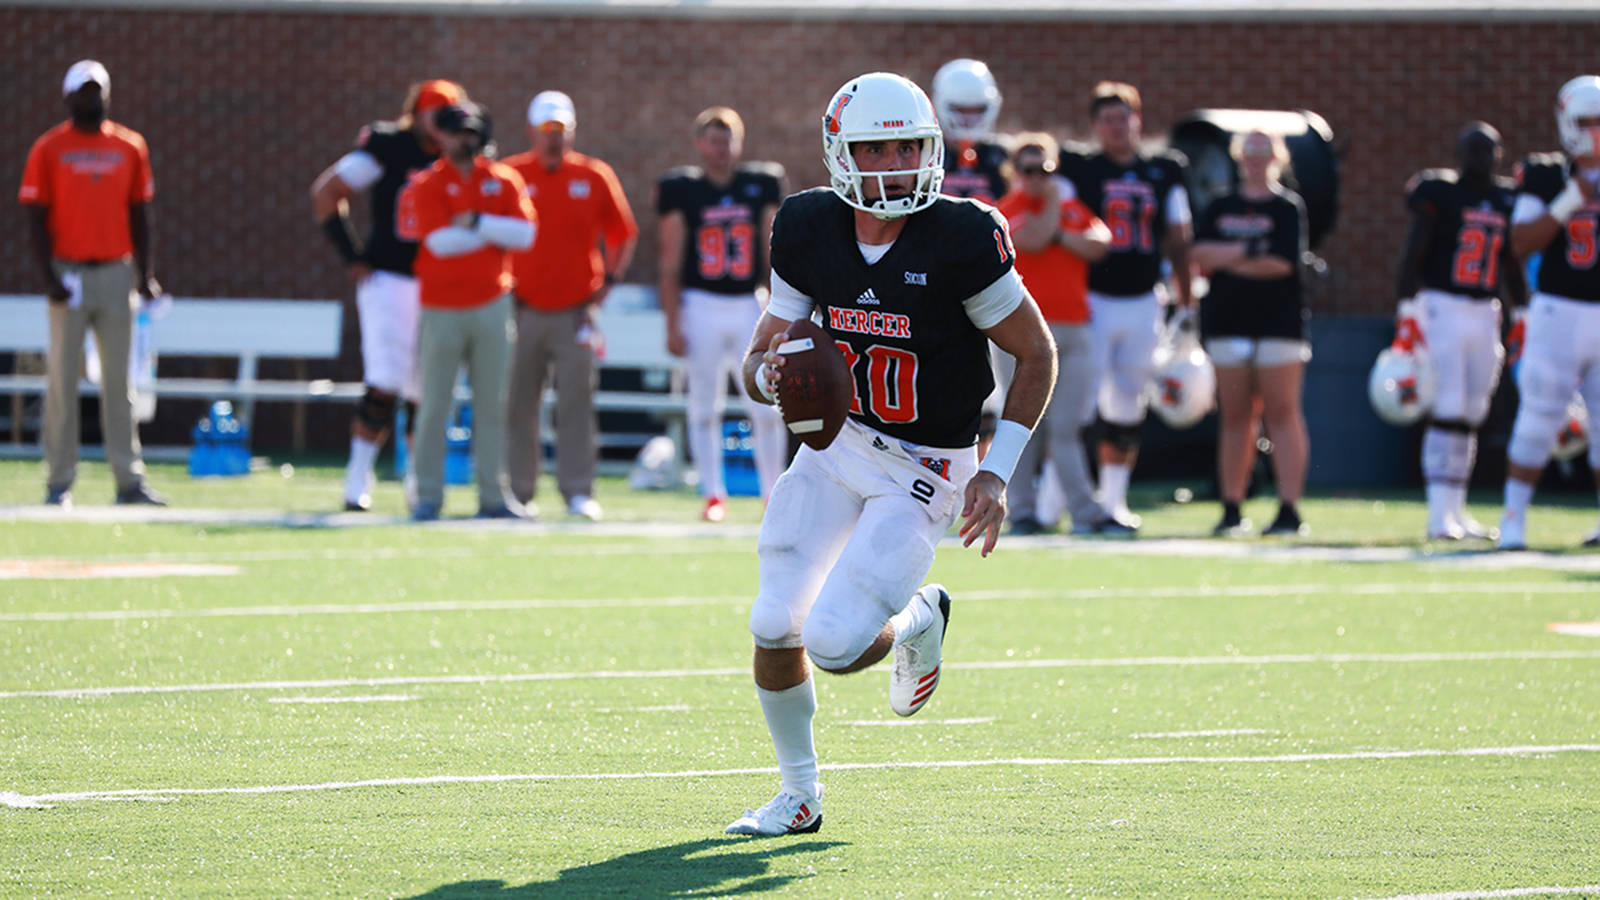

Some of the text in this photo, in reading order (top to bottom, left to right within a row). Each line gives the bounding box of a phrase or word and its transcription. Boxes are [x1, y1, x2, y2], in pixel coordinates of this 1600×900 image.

[699, 222, 755, 278] 93
[1104, 197, 1157, 252] 61
[1454, 226, 1504, 289] 21
[828, 305, 912, 338] MERCER
[910, 479, 935, 505] 10
